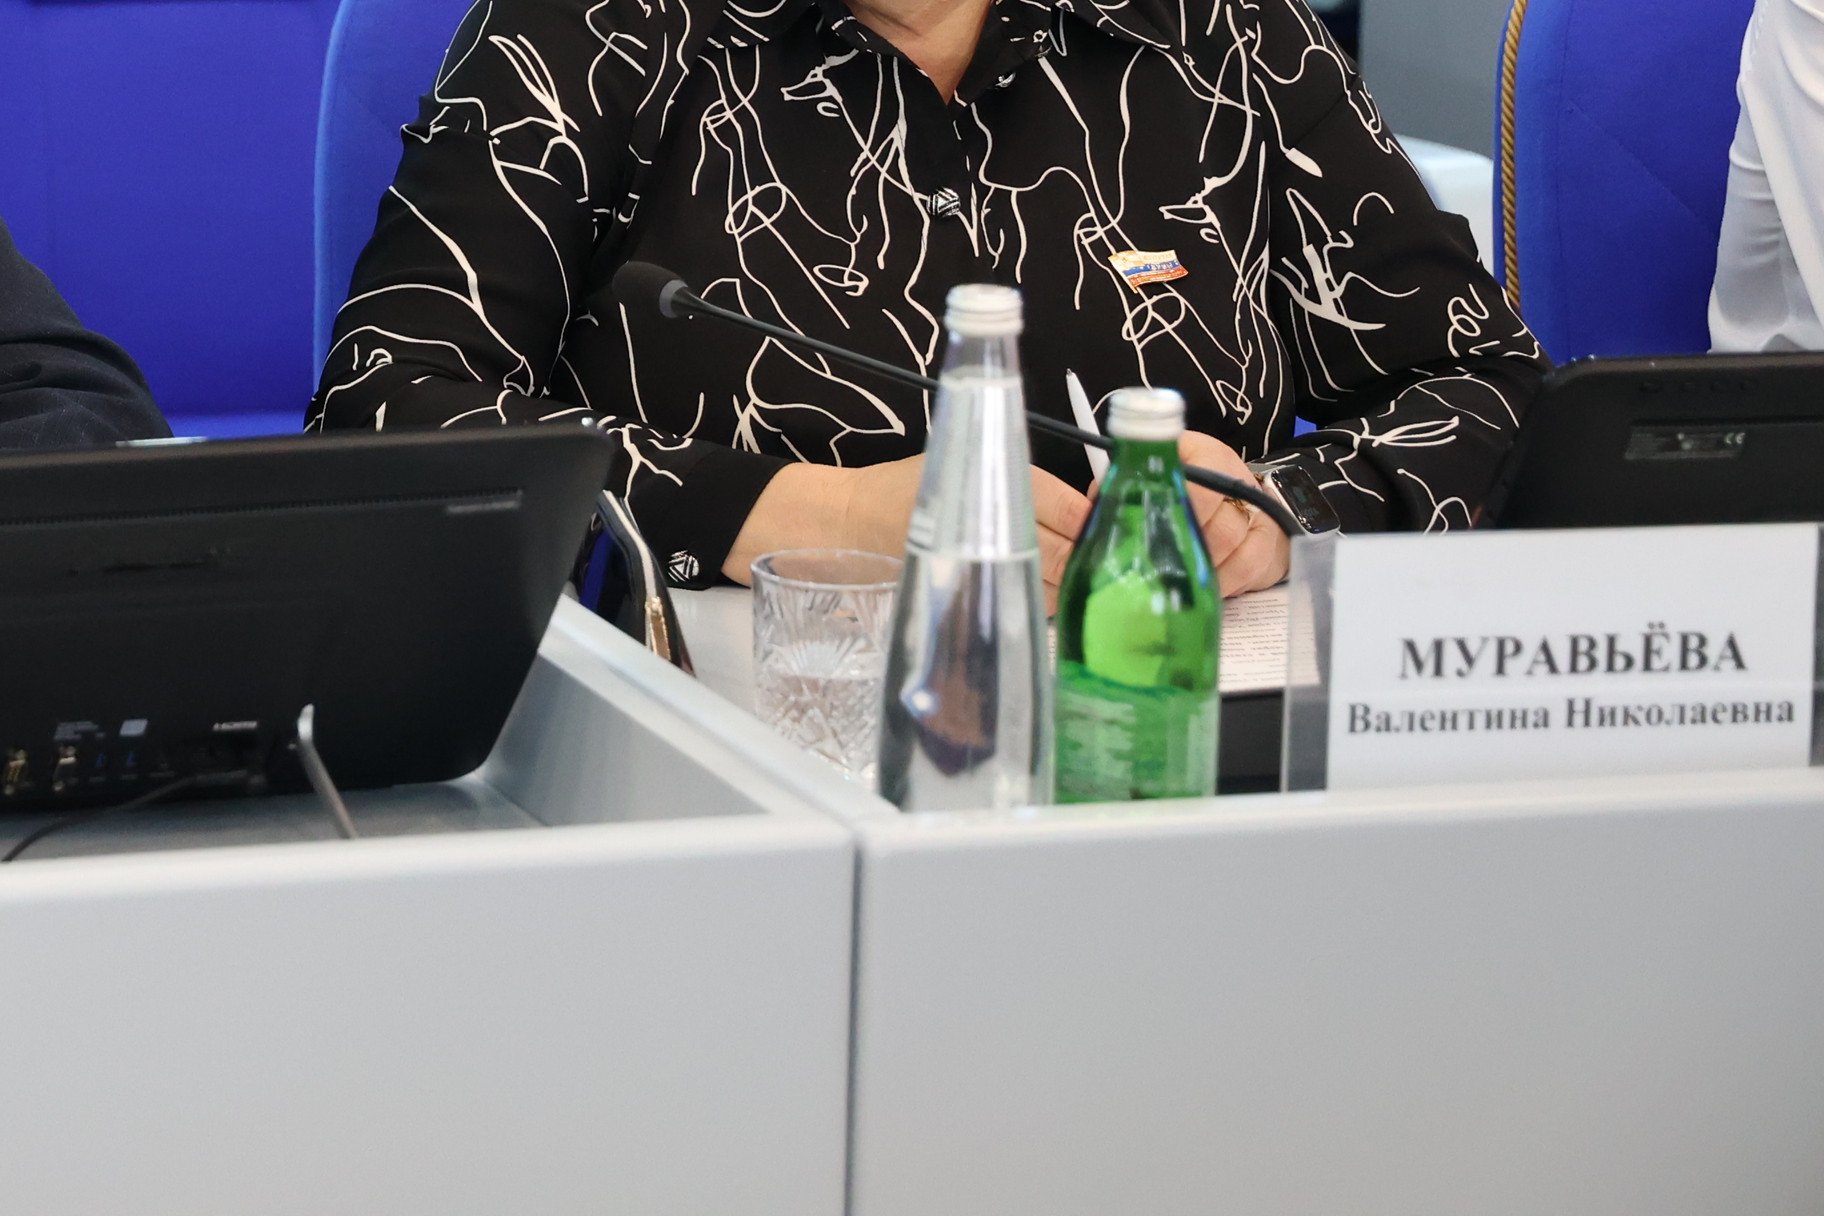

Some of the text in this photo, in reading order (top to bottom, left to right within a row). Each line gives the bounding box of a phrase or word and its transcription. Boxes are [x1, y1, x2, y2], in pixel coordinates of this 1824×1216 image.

[1399, 621, 1749, 680] МУРАВЬЁВА
[1347, 696, 1796, 735] Валентина Николаевна
